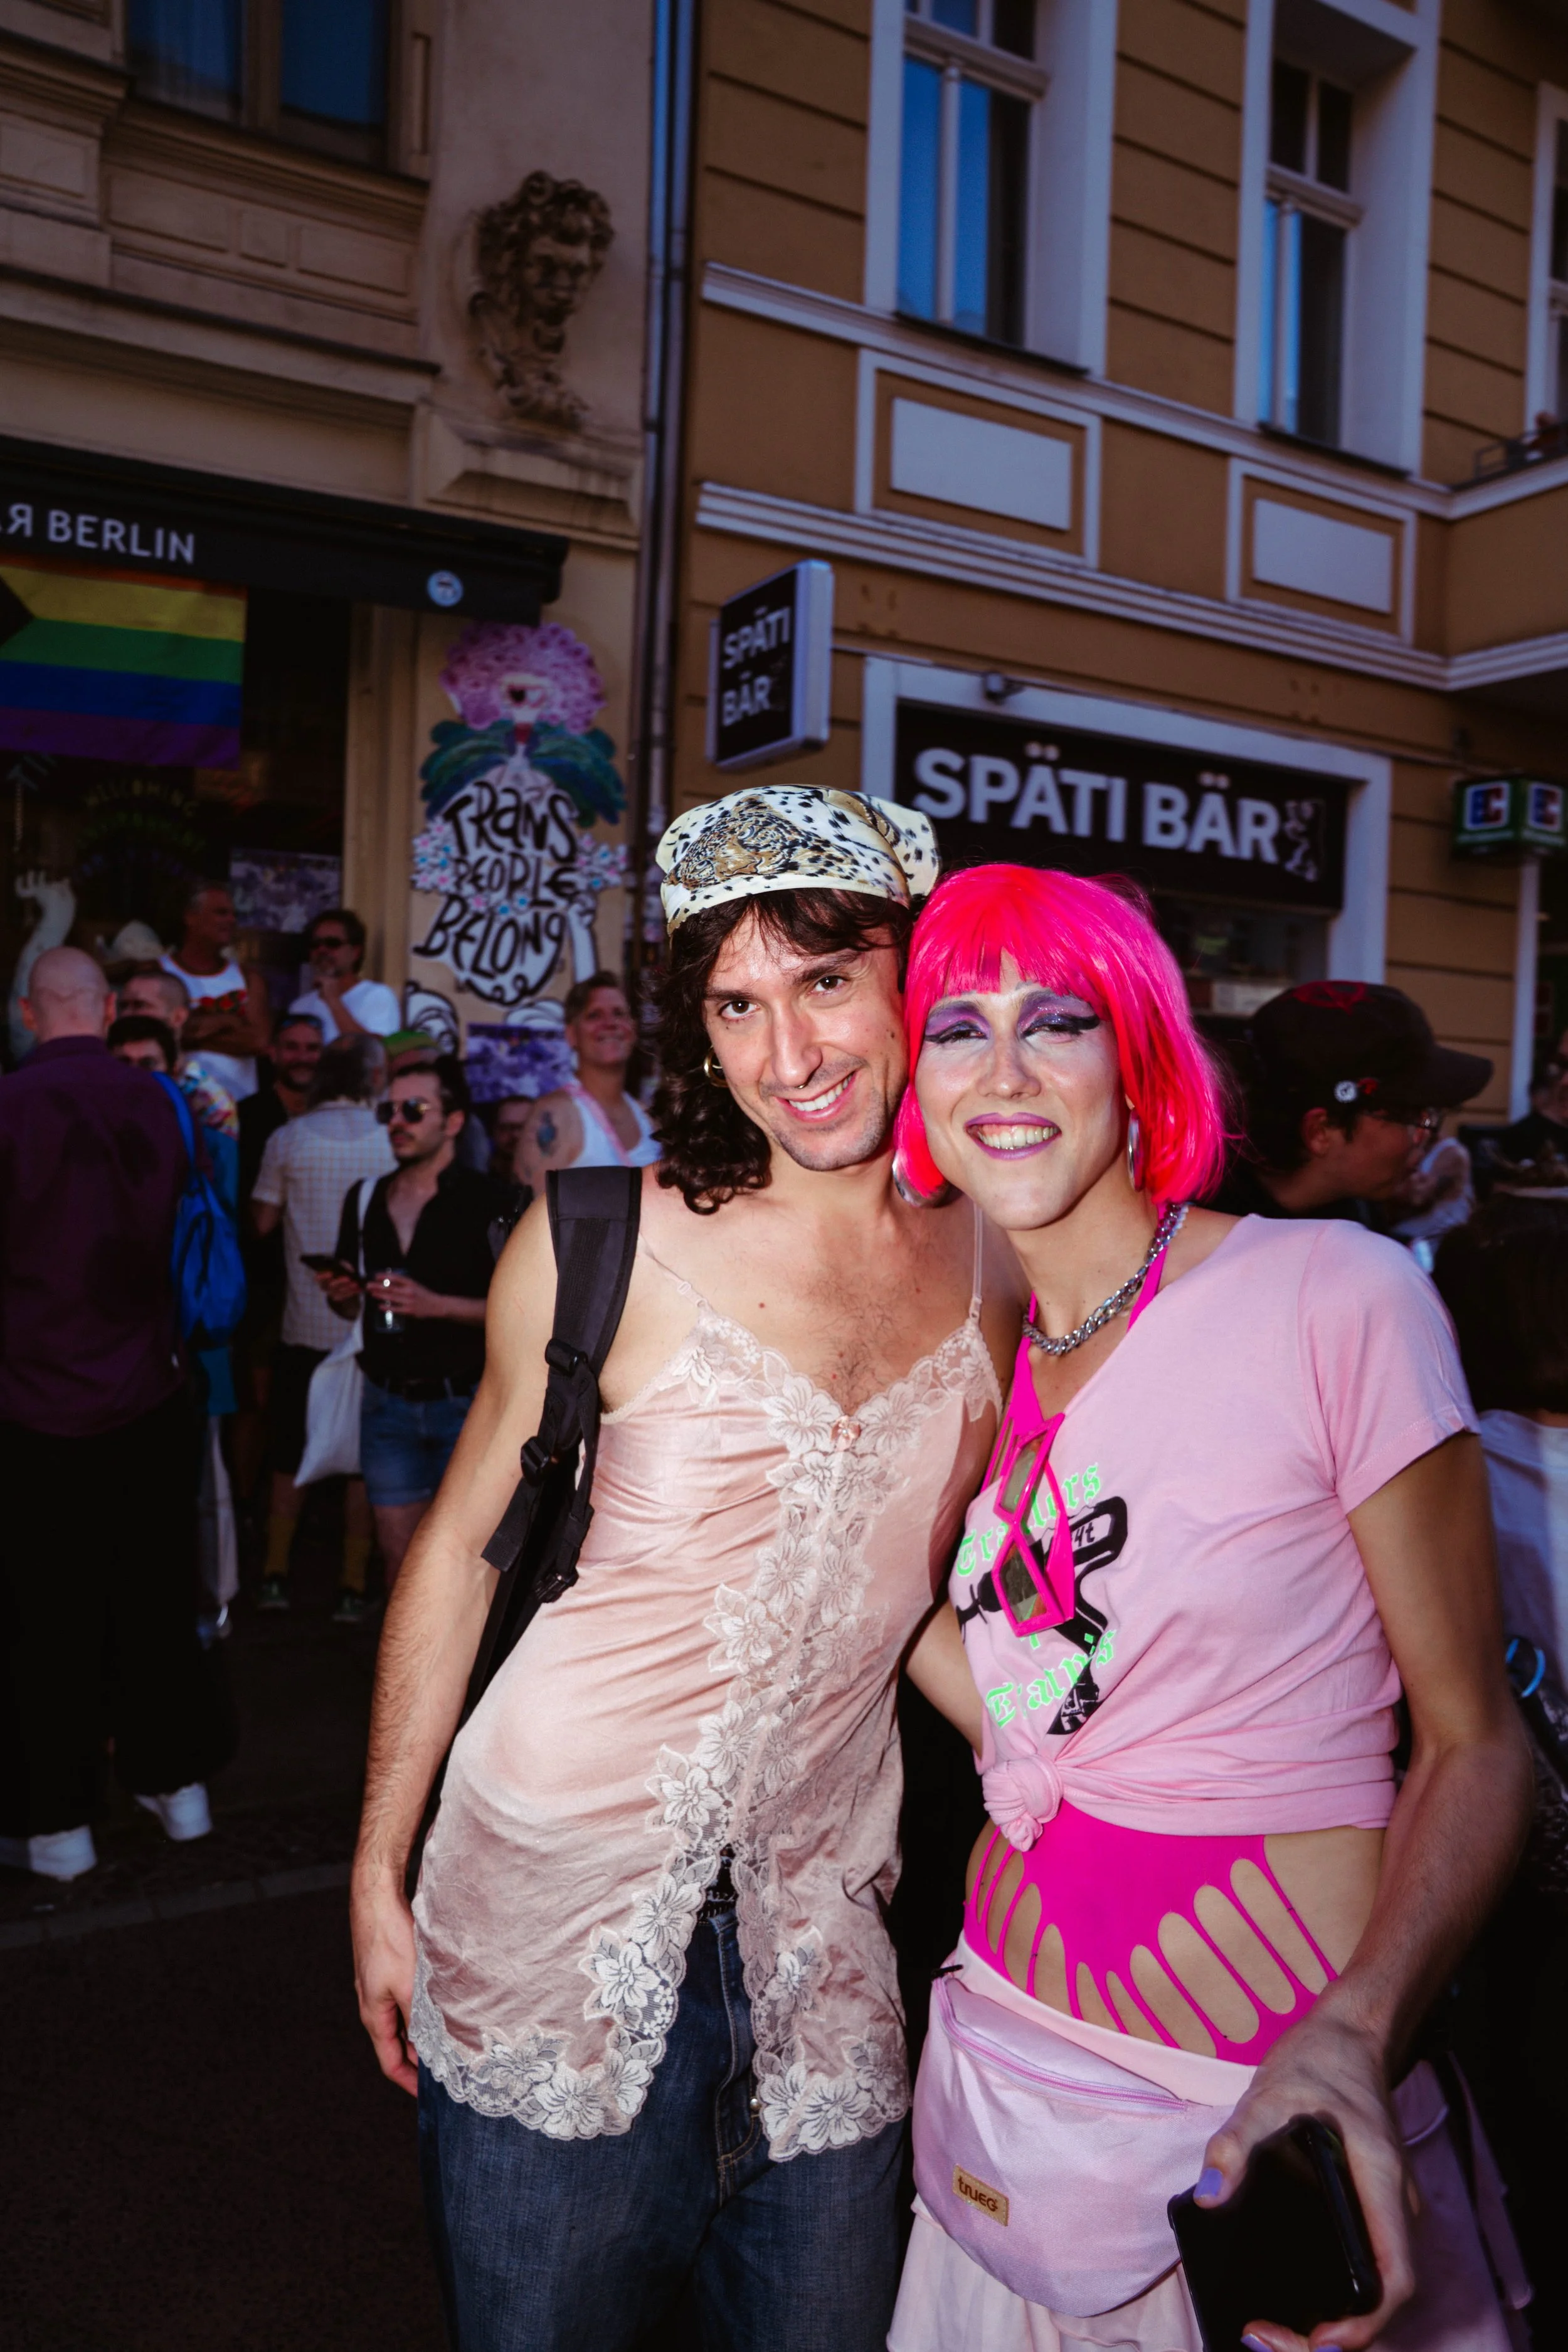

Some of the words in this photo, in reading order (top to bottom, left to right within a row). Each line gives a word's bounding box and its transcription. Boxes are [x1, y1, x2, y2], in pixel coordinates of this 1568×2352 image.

[47, 509, 195, 565] BERLIN
[723, 606, 790, 669] SPÄTI
[723, 670, 771, 727] BÄR
[913, 741, 1126, 842] SPÄTI
[1143, 771, 1279, 864] BÄR
[453, 851, 580, 907] PEOPLE
